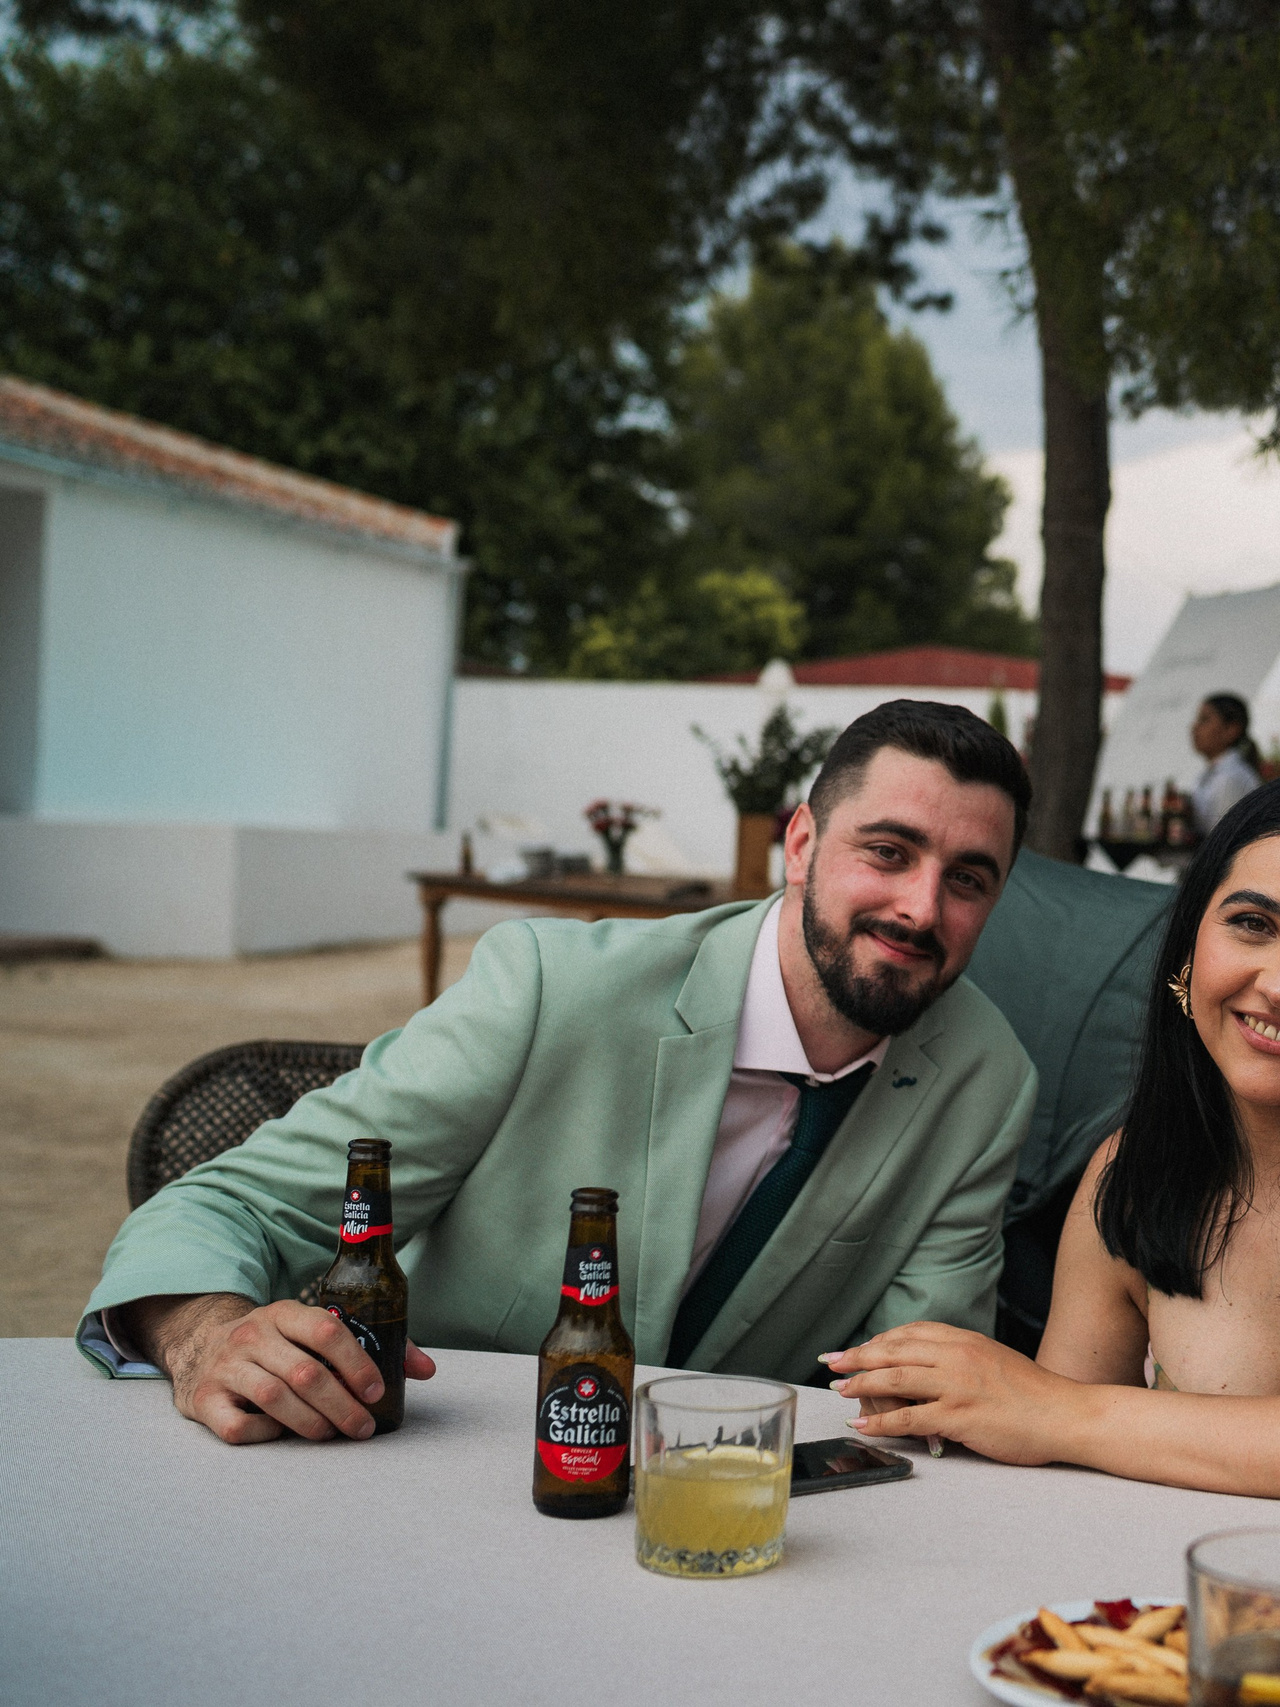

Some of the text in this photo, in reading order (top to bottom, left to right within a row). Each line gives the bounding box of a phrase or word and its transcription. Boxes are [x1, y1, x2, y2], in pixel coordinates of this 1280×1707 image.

[344, 1201, 371, 1211] Estrella
[344, 1210, 369, 1219] Galicia
[343, 1220, 369, 1237] Mini
[578, 1260, 611, 1272] Estrella
[579, 1270, 611, 1280] Galicia
[579, 1279, 611, 1300] Mini
[547, 1399, 620, 1424] Estrella
[549, 1420, 617, 1445] Galicia
[560, 1450, 602, 1466] Especial
